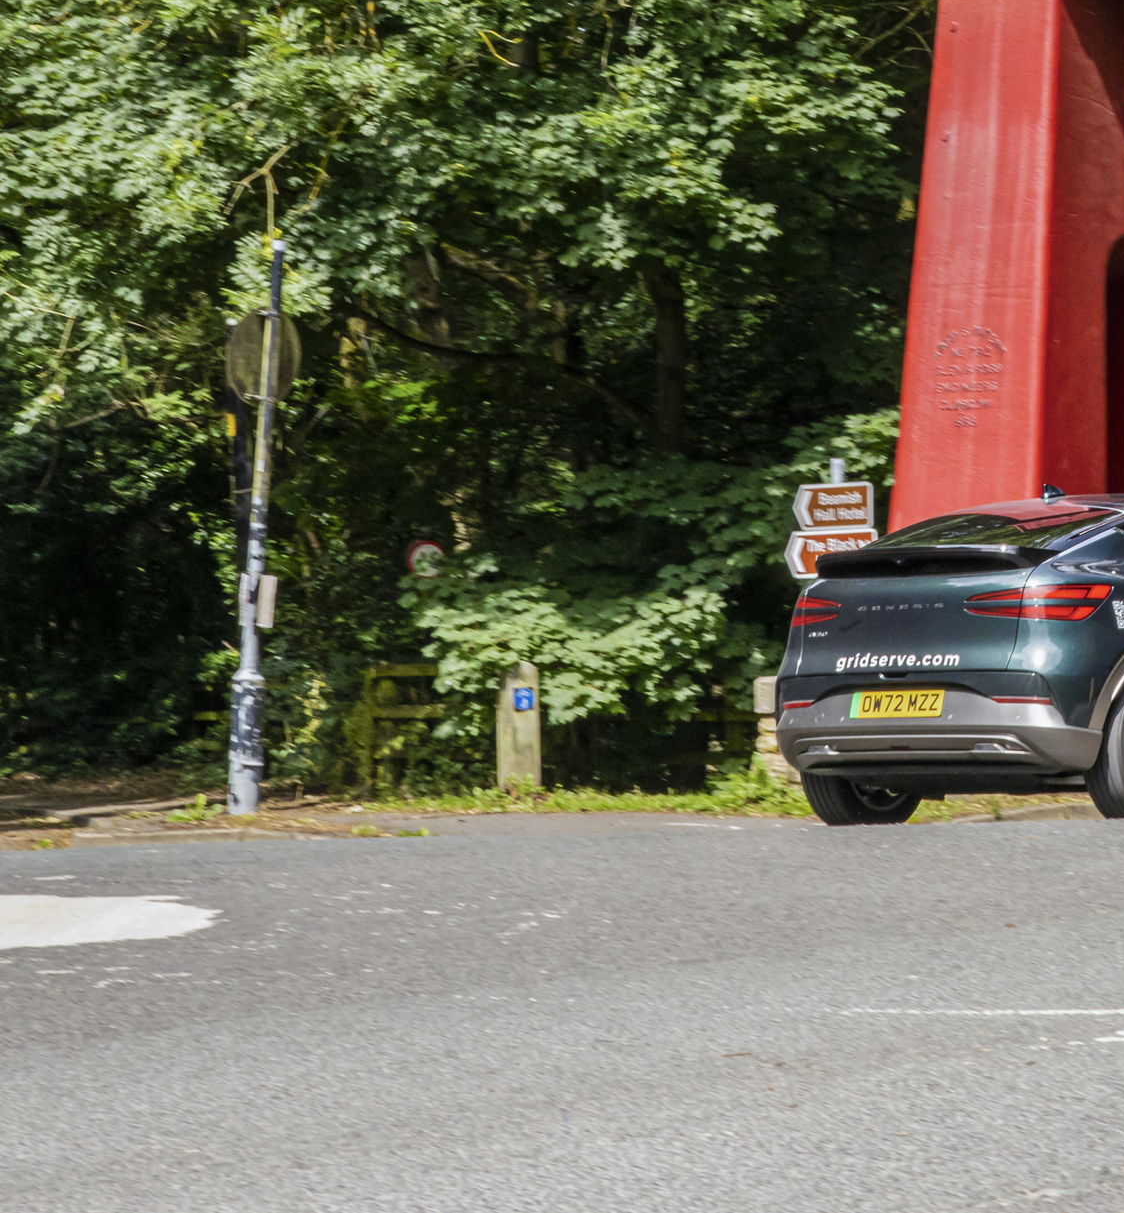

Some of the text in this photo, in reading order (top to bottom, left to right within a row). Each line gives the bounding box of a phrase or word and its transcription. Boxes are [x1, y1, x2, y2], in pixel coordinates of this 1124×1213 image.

[818, 491, 863, 505] Beamish
[813, 506, 868, 521] Hall Hotel
[806, 539, 826, 552] The
[857, 602, 944, 611] GENESIS
[835, 653, 960, 672] gridserve.com
[862, 694, 940, 713] OW72 MZZ
